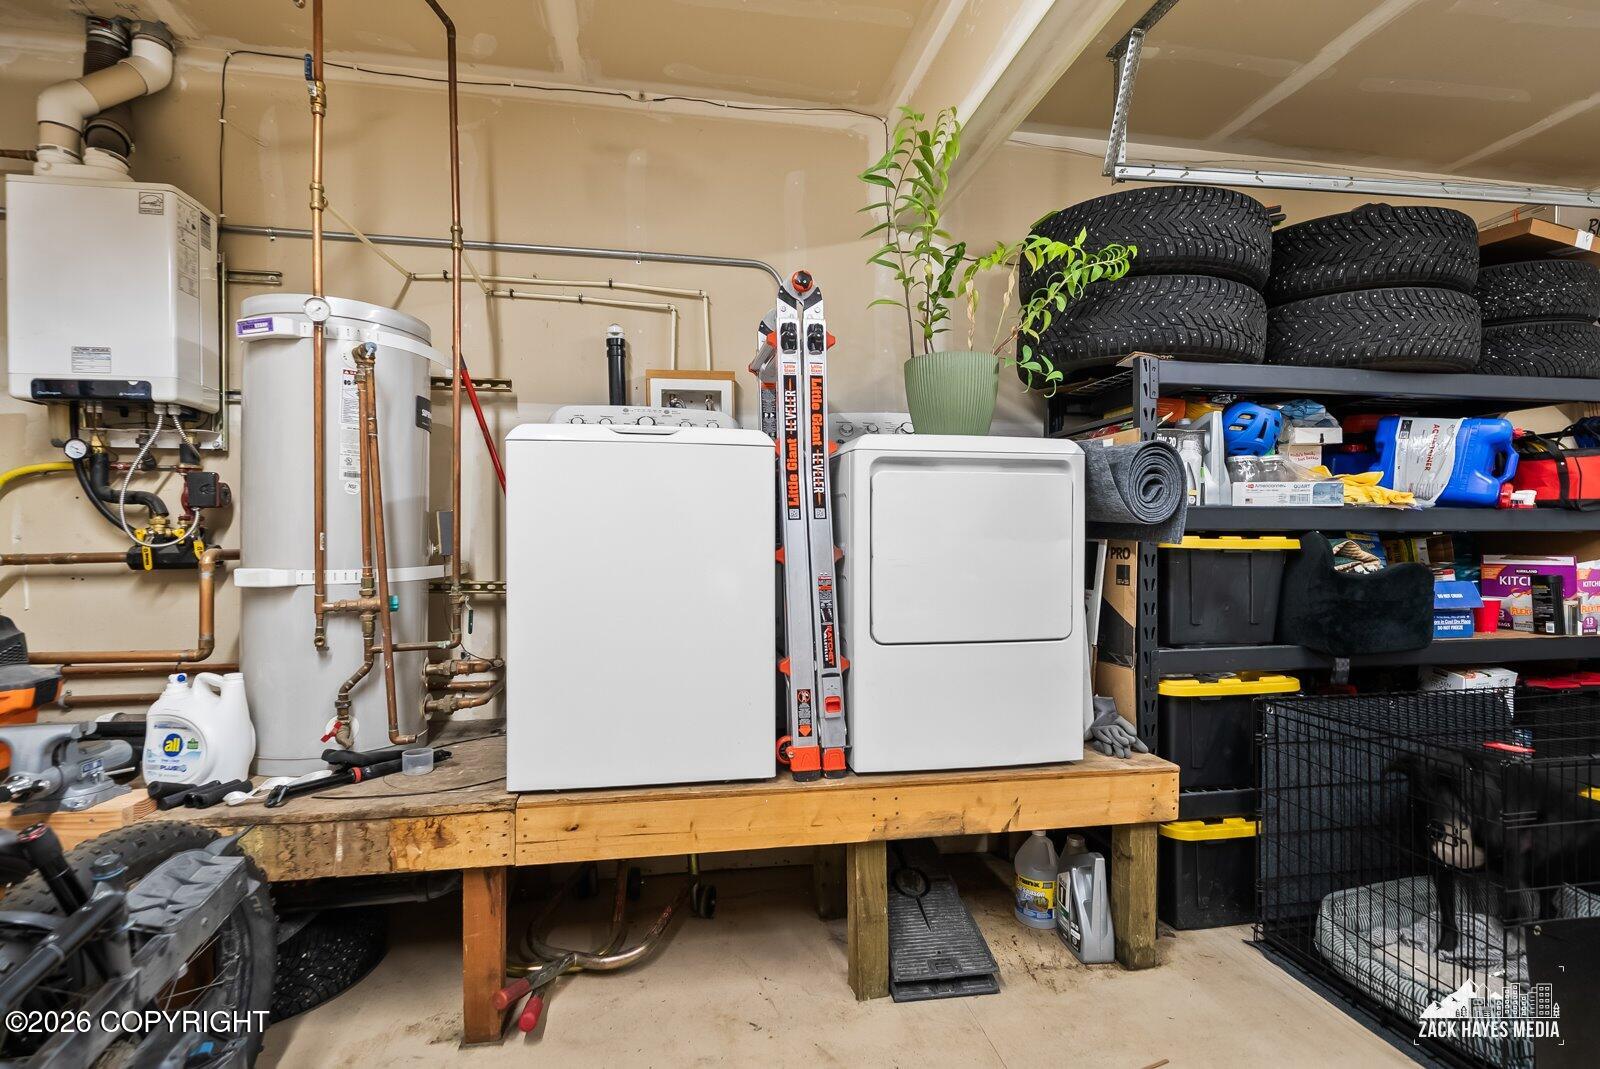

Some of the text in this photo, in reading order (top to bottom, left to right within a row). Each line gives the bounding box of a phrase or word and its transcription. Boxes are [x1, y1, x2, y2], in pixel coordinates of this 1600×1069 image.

[785, 390, 798, 431] LEVELER
[810, 378, 824, 446] Little Giant
[786, 438, 800, 507] Little Giant
[812, 453, 825, 494] LEVELER
[1110, 546, 1131, 560] PRO
[164, 738, 180, 752] all
